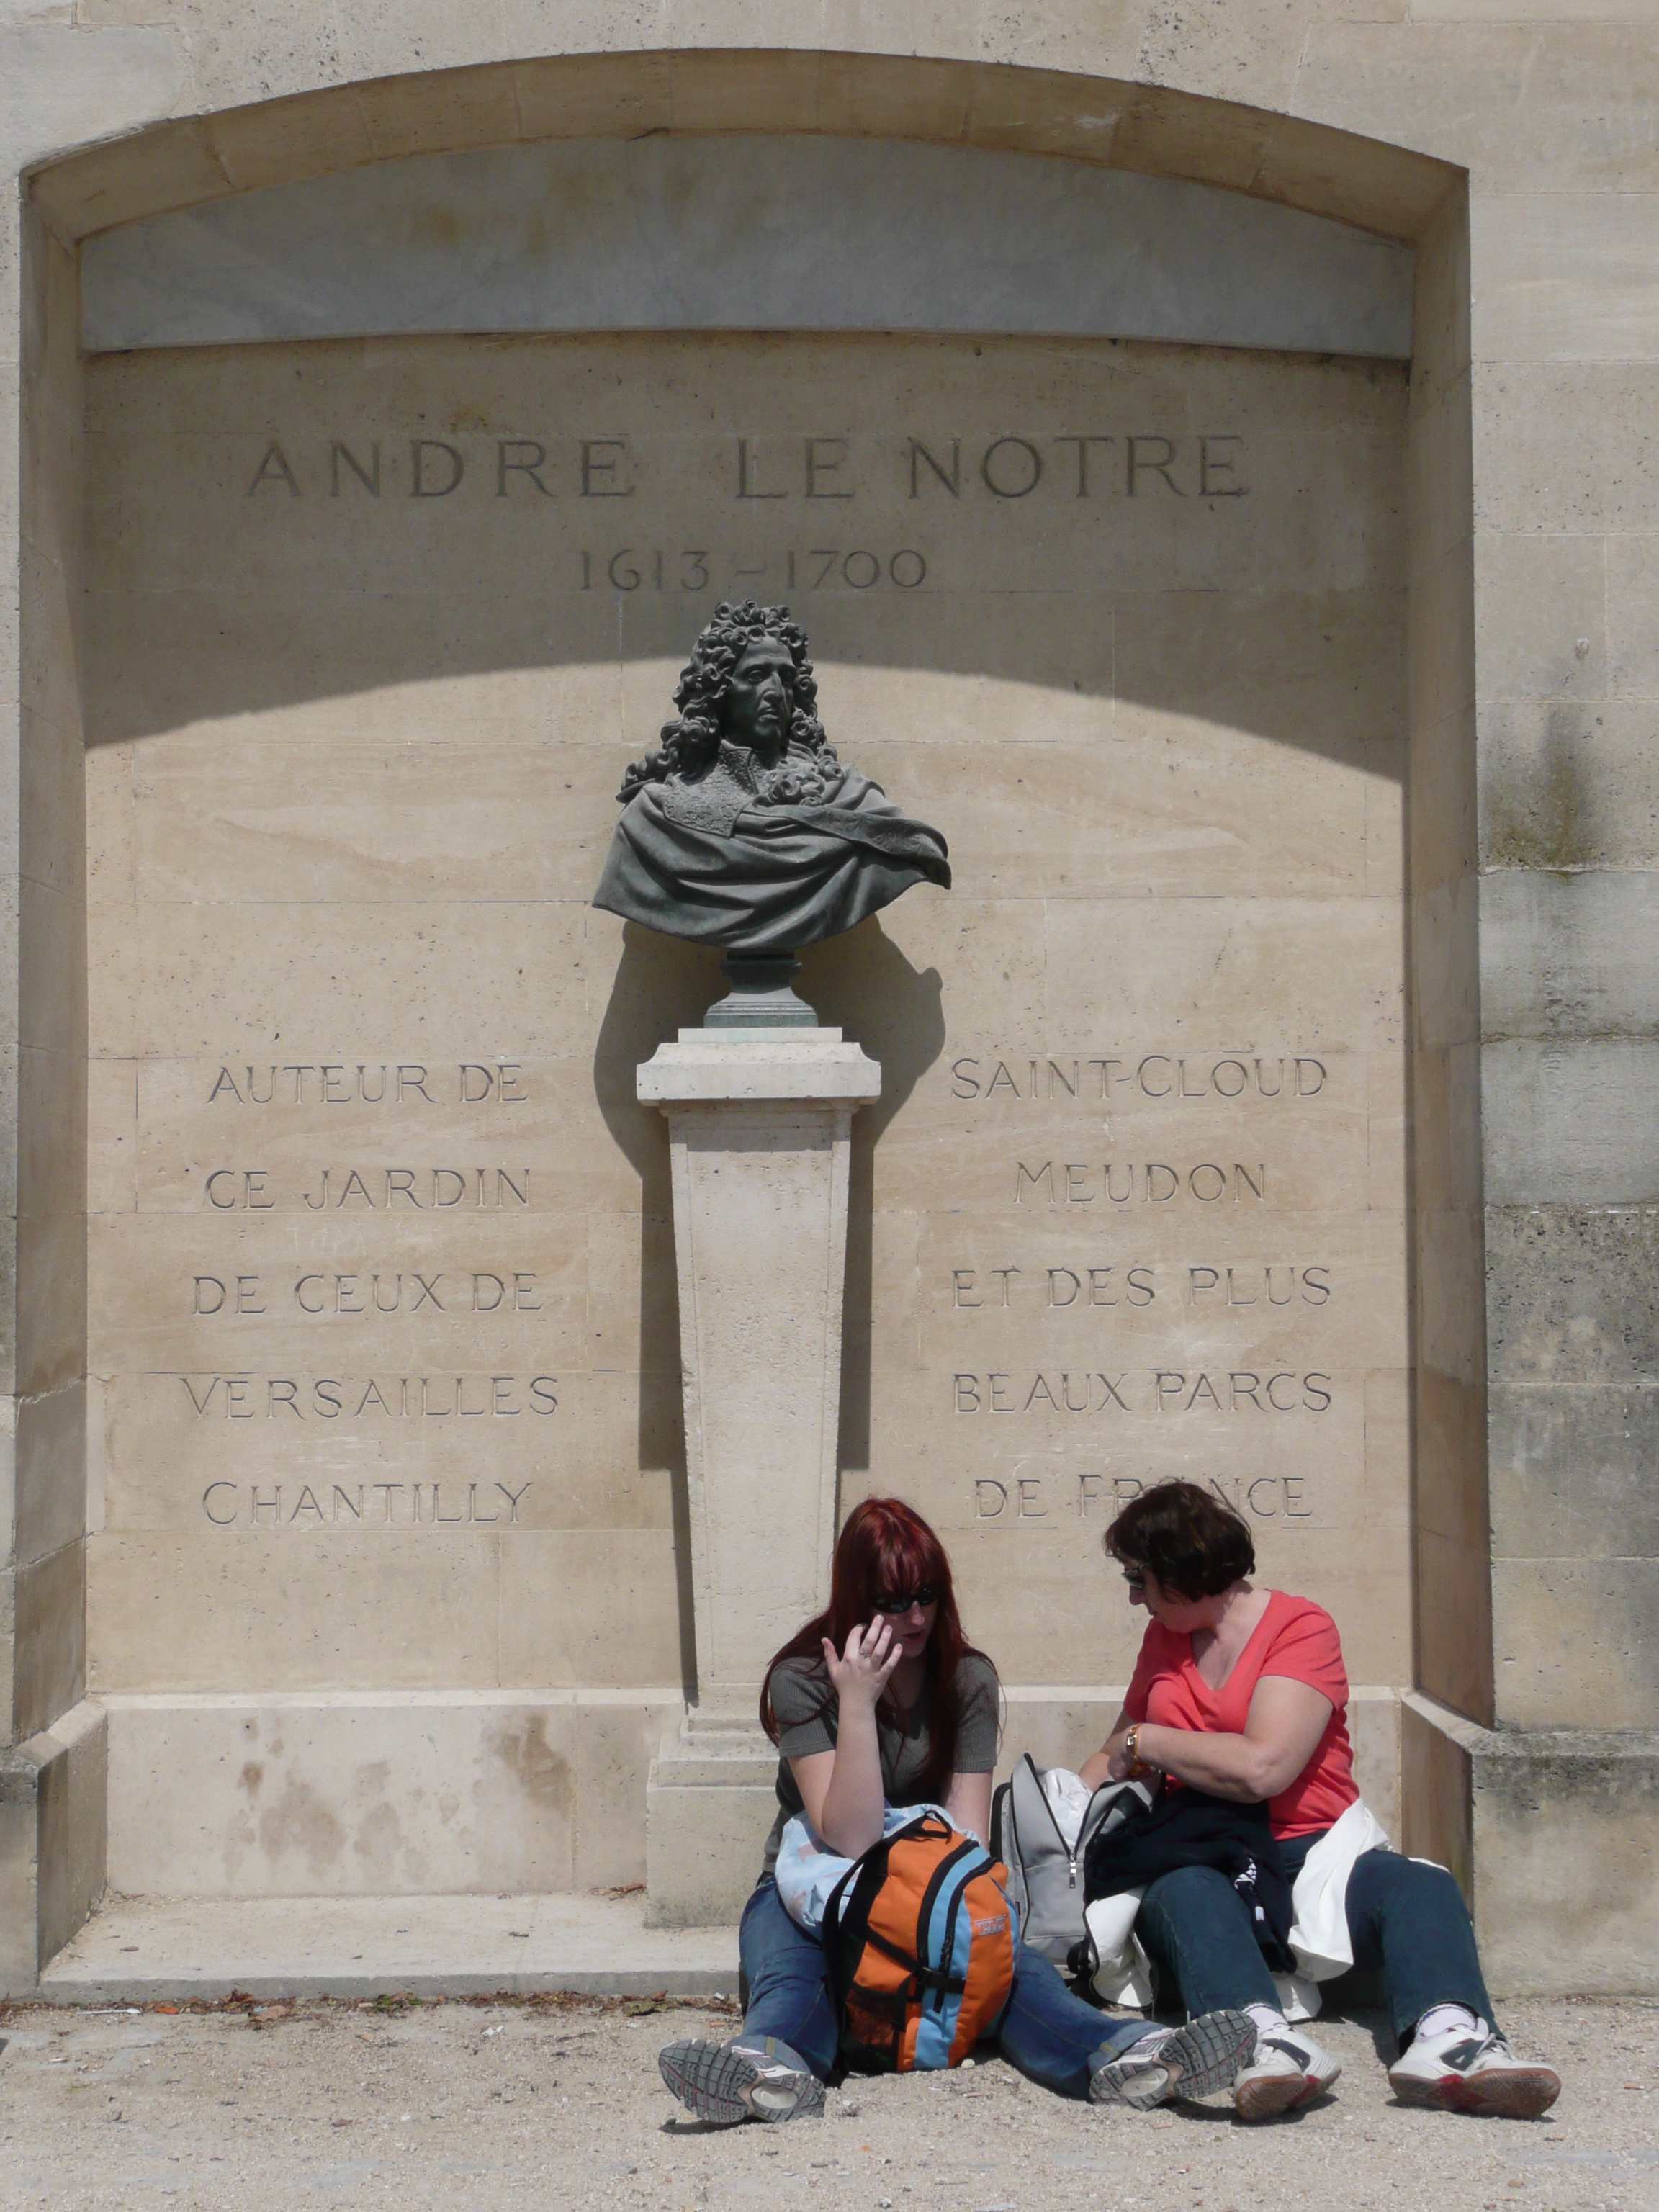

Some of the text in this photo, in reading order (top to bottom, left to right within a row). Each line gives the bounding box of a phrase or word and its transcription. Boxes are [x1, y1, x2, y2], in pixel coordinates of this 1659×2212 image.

[245, 436, 1251, 500] ANDRE LE NOTRE
[207, 1064, 529, 1104] AUTEUR DE
[951, 1055, 1327, 1100] SAINT-CLOUD
[204, 1169, 531, 1210] CE JARDIN
[1013, 1161, 1266, 1204] MEUDON
[192, 1272, 543, 1316] DE CEUX DE
[951, 1265, 1331, 1308] ET DES PLUS
[179, 1376, 559, 1420] VERSAILLES
[952, 1372, 1332, 1413] BEAUX PARCS
[202, 1481, 534, 1525] CHANTILLY
[974, 1473, 1313, 1519] DE FRNCE
